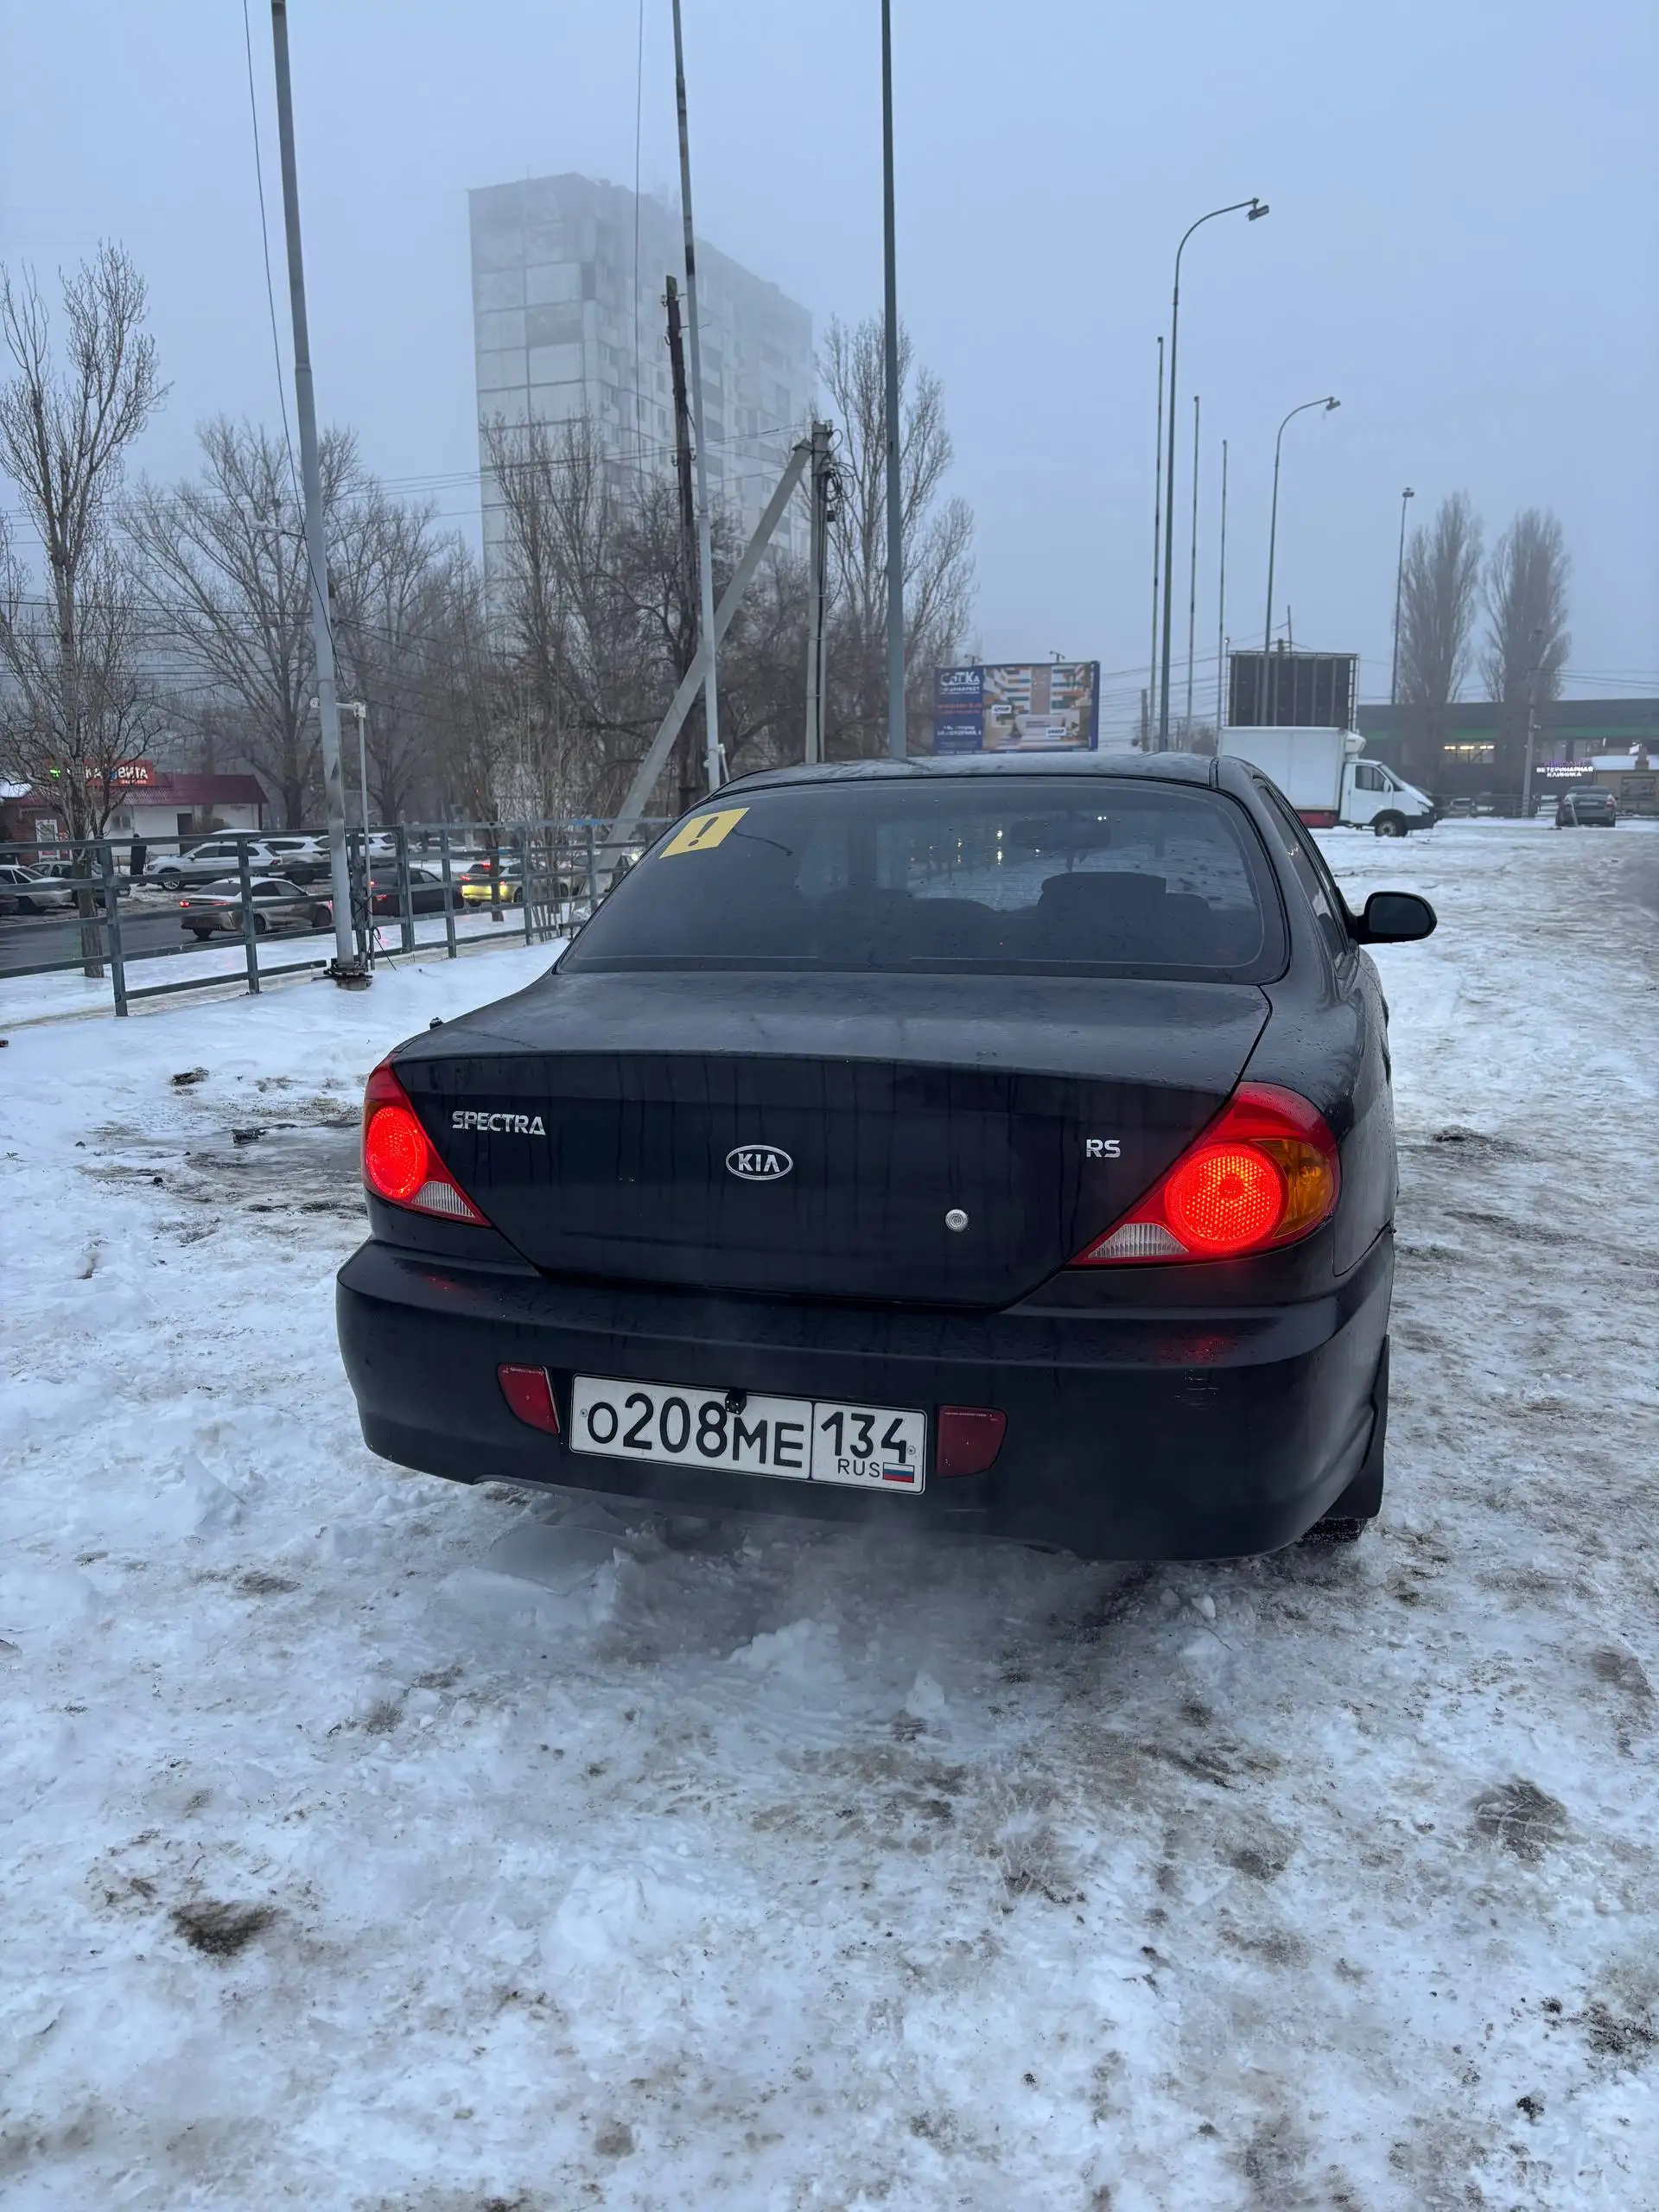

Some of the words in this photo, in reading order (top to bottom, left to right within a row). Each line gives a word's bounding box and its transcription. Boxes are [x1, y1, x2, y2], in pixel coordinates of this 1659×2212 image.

[118, 766, 149, 779] ВИТА
[452, 1110, 546, 1136] SPECTRA
[1085, 1138, 1122, 1159] RS
[737, 1153, 780, 1173] KIA
[821, 1411, 907, 1465] 134
[837, 1458, 880, 1478] RUS
